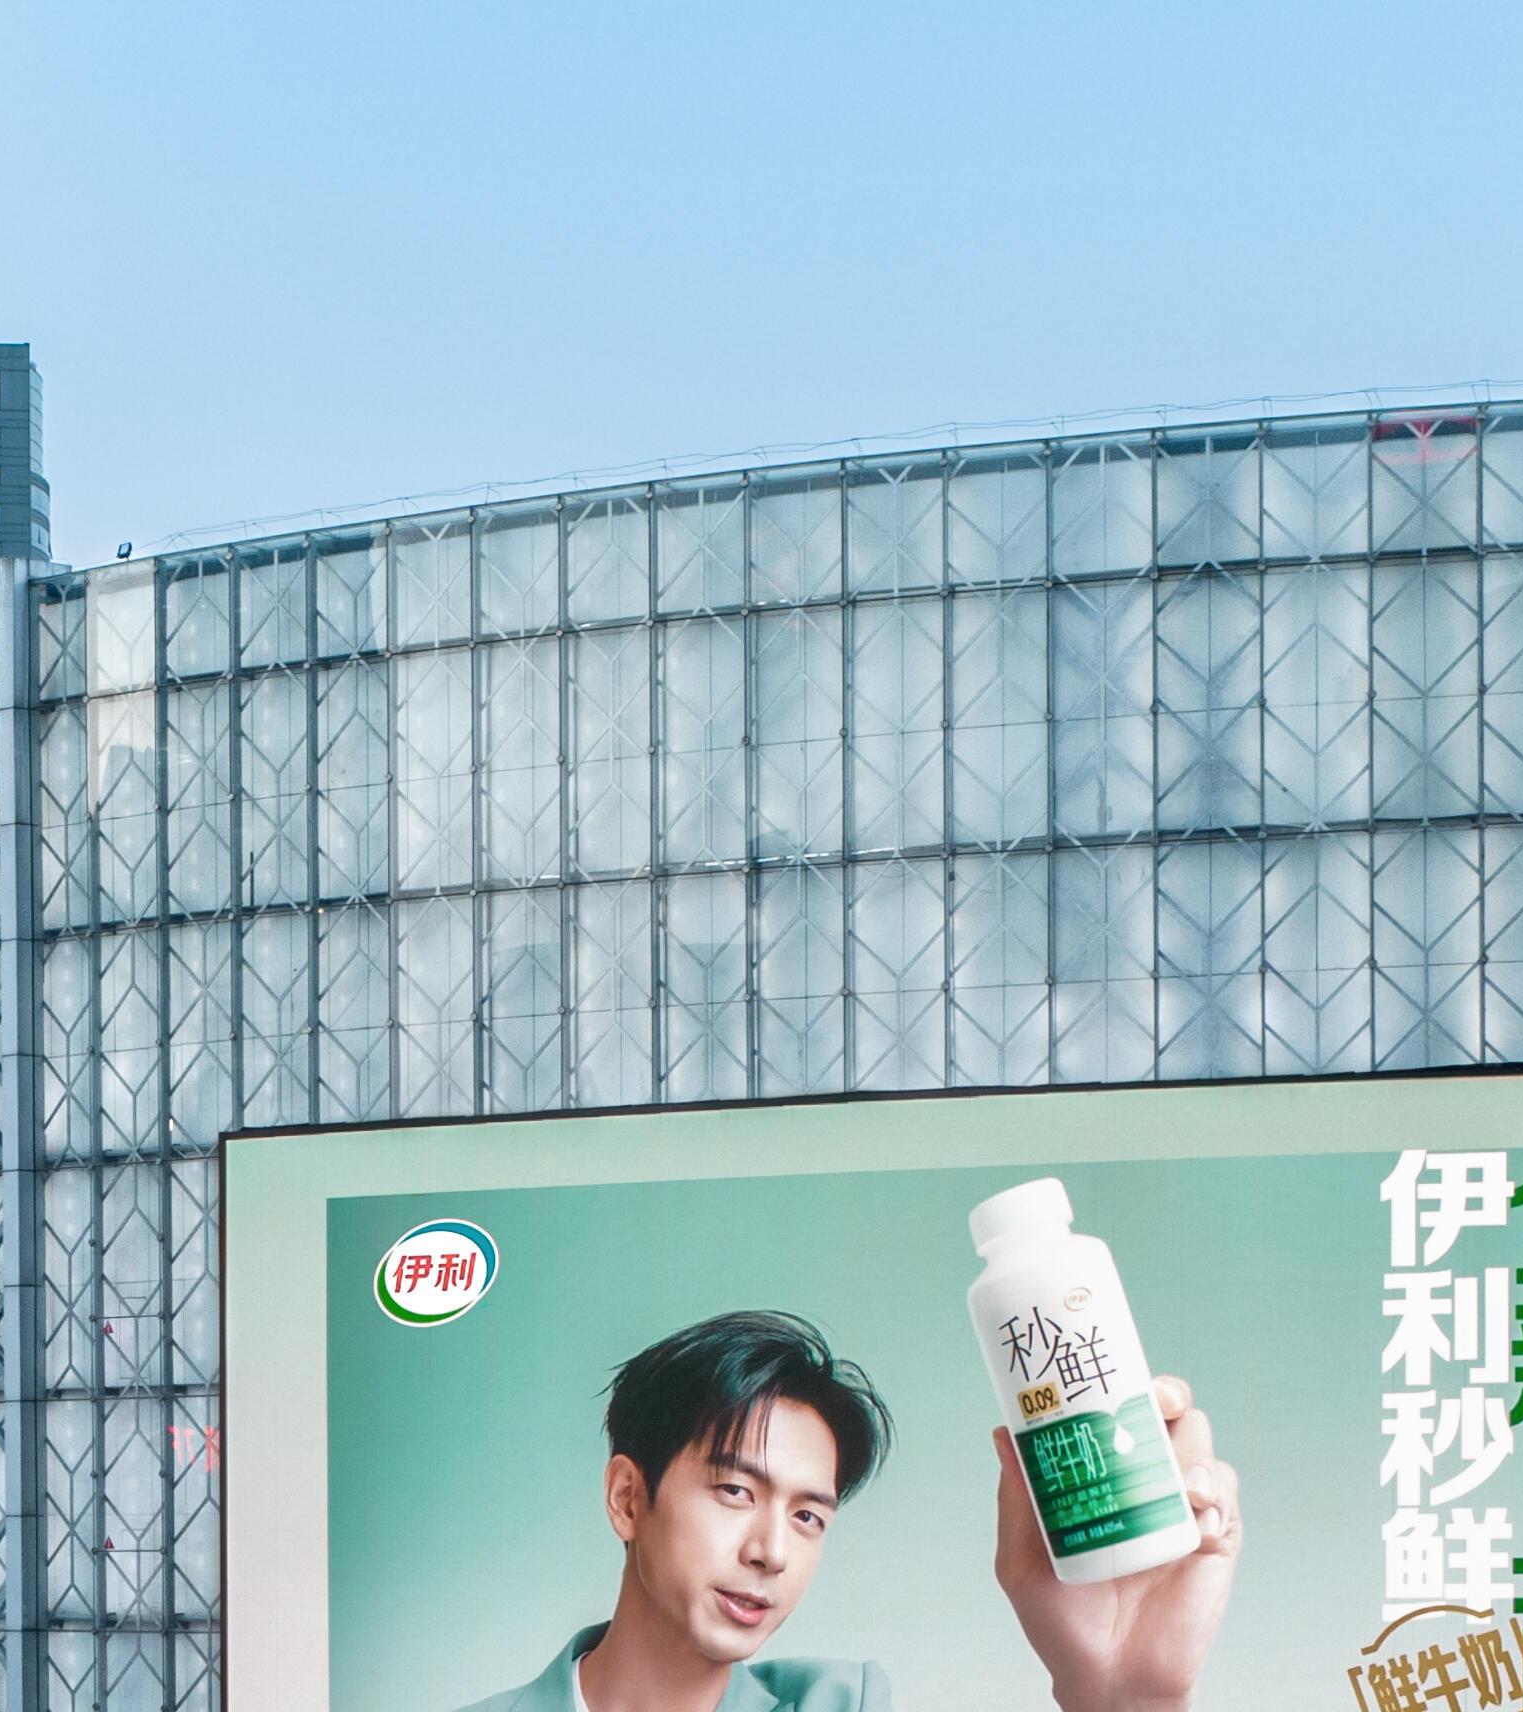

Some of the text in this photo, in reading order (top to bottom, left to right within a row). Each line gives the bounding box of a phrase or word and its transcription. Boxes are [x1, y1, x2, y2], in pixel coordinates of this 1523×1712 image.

[392, 1252, 477, 1293] 伊利
[998, 1306, 1116, 1402] 秒鲜
[1380, 1149, 1515, 1624] 伊利秒鲜
[1033, 1422, 1107, 1493] 鲜牛奶
